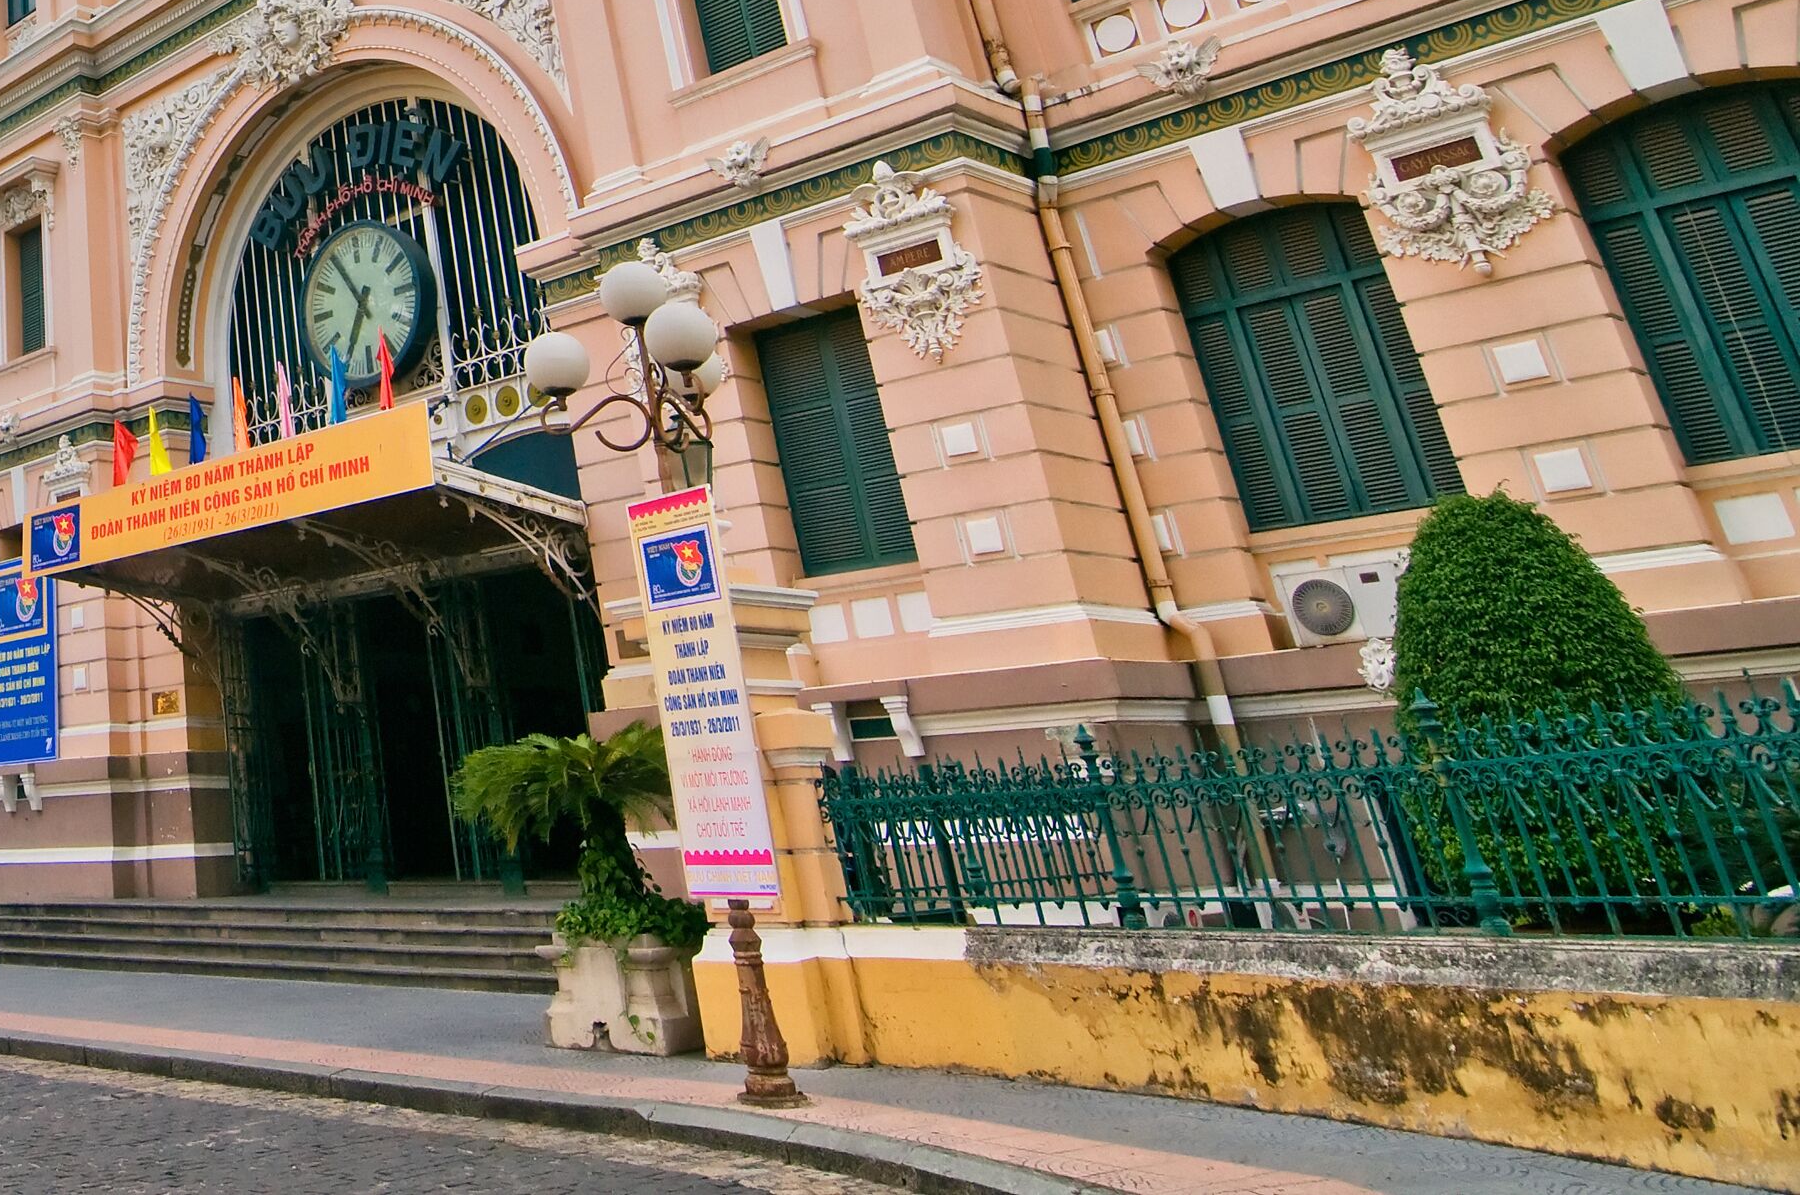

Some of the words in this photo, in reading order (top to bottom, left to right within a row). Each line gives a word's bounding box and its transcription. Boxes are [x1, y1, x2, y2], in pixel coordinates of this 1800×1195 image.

[400, 183, 435, 205] MINH
[131, 483, 146, 506] KỶ
[150, 479, 181, 501] NIỆM
[185, 474, 201, 491] 80
[204, 464, 234, 486] NĂM
[238, 451, 283, 477] THÀNH
[287, 442, 314, 465] LẬP
[91, 518, 123, 540] ĐOÀN
[126, 508, 166, 532] THANH
[170, 498, 200, 521] NIÊN
[204, 486, 240, 513] CỘNG
[244, 477, 272, 502] SẢN
[277, 469, 295, 494] HỒ
[299, 464, 324, 488] CHÍ
[328, 456, 370, 481] MINH
[686, 666, 708, 684] THANH
[708, 661, 726, 680] NIÊN
[720, 689, 739, 705] MINH
